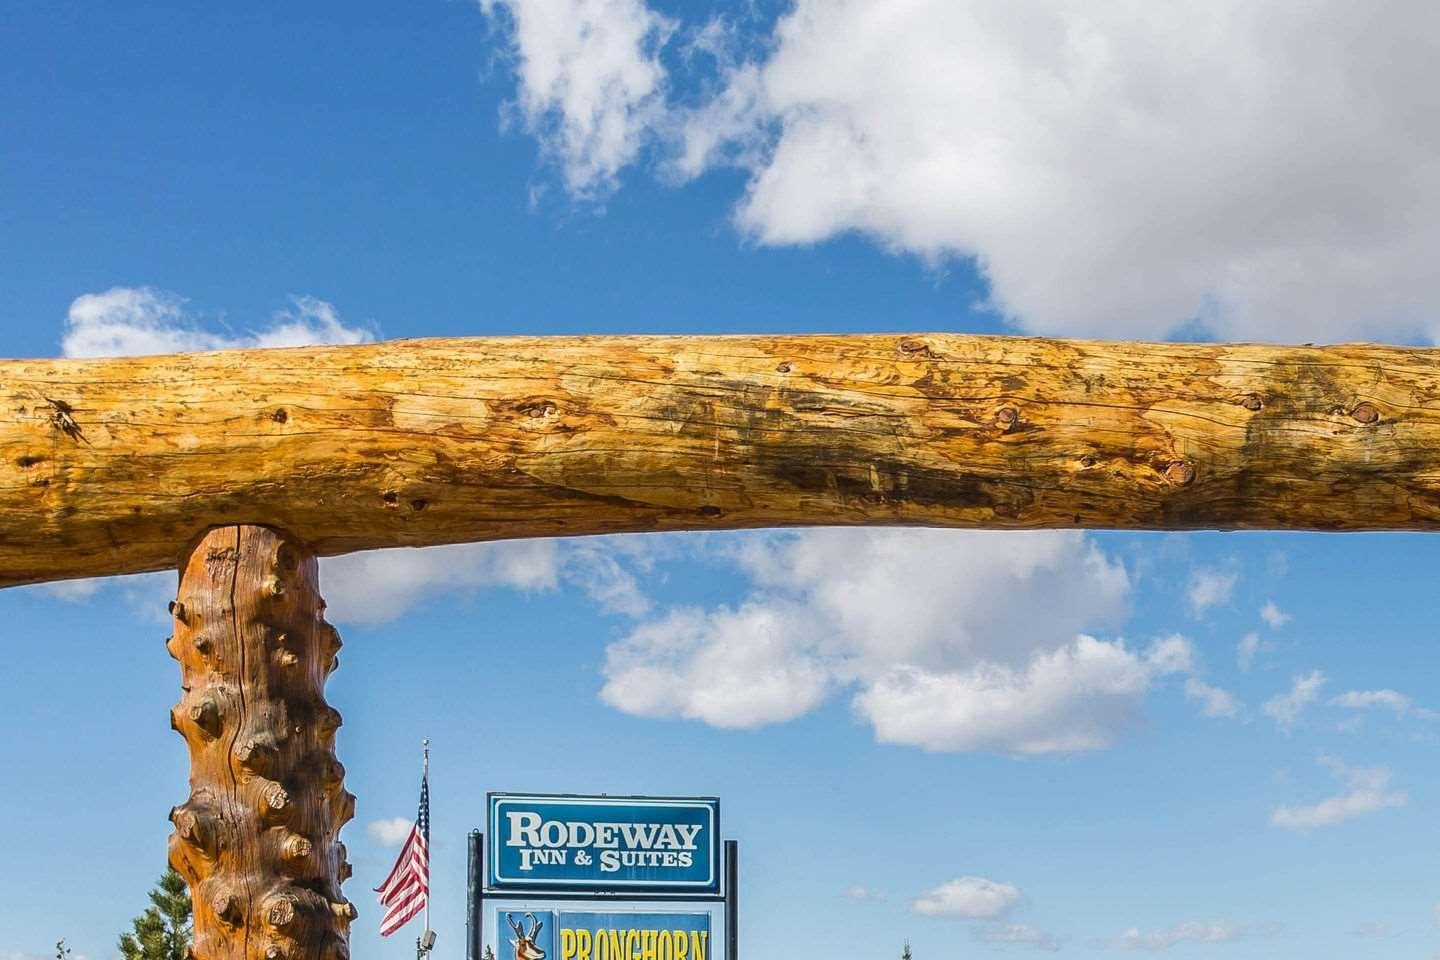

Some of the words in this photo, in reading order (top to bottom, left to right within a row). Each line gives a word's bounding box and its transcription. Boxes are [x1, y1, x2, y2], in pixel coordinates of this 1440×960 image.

[506, 811, 703, 850] RODEWAY
[519, 849, 568, 870] INN
[574, 849, 593, 866] &
[600, 850, 694, 872] SUITES
